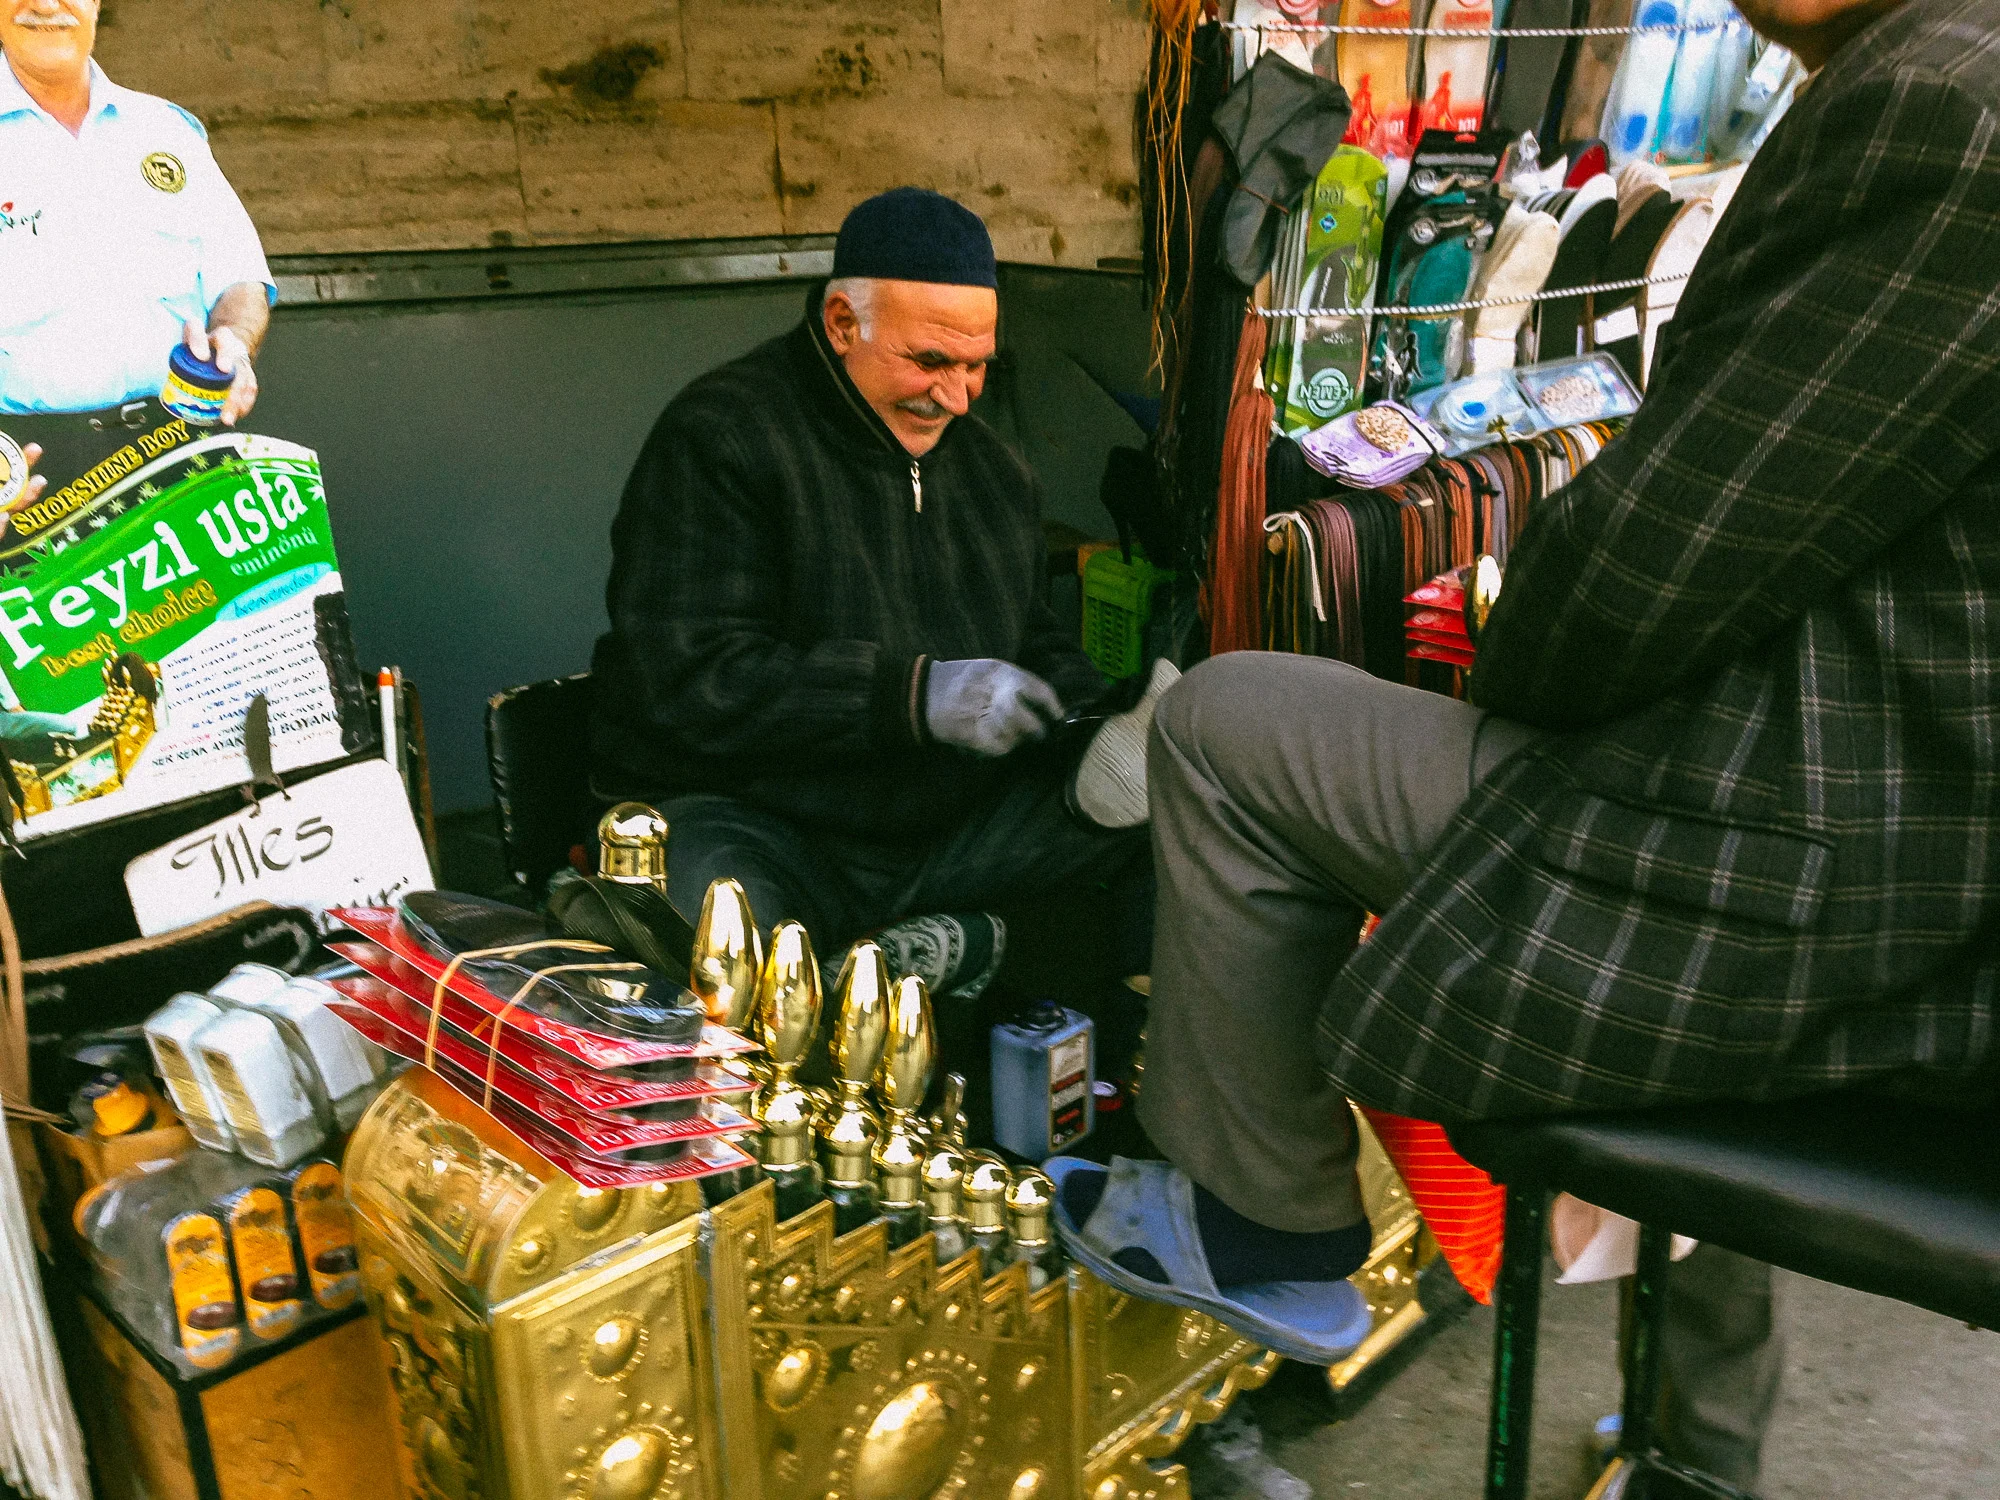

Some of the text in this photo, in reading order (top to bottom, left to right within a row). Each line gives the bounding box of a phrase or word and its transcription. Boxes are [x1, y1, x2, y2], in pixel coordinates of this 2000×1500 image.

[1299, 384, 1354, 401] ICEMEN
[137, 419, 190, 459] BOY
[197, 465, 309, 558] usta
[230, 526, 319, 576] eminönü
[119, 579, 219, 644] choice
